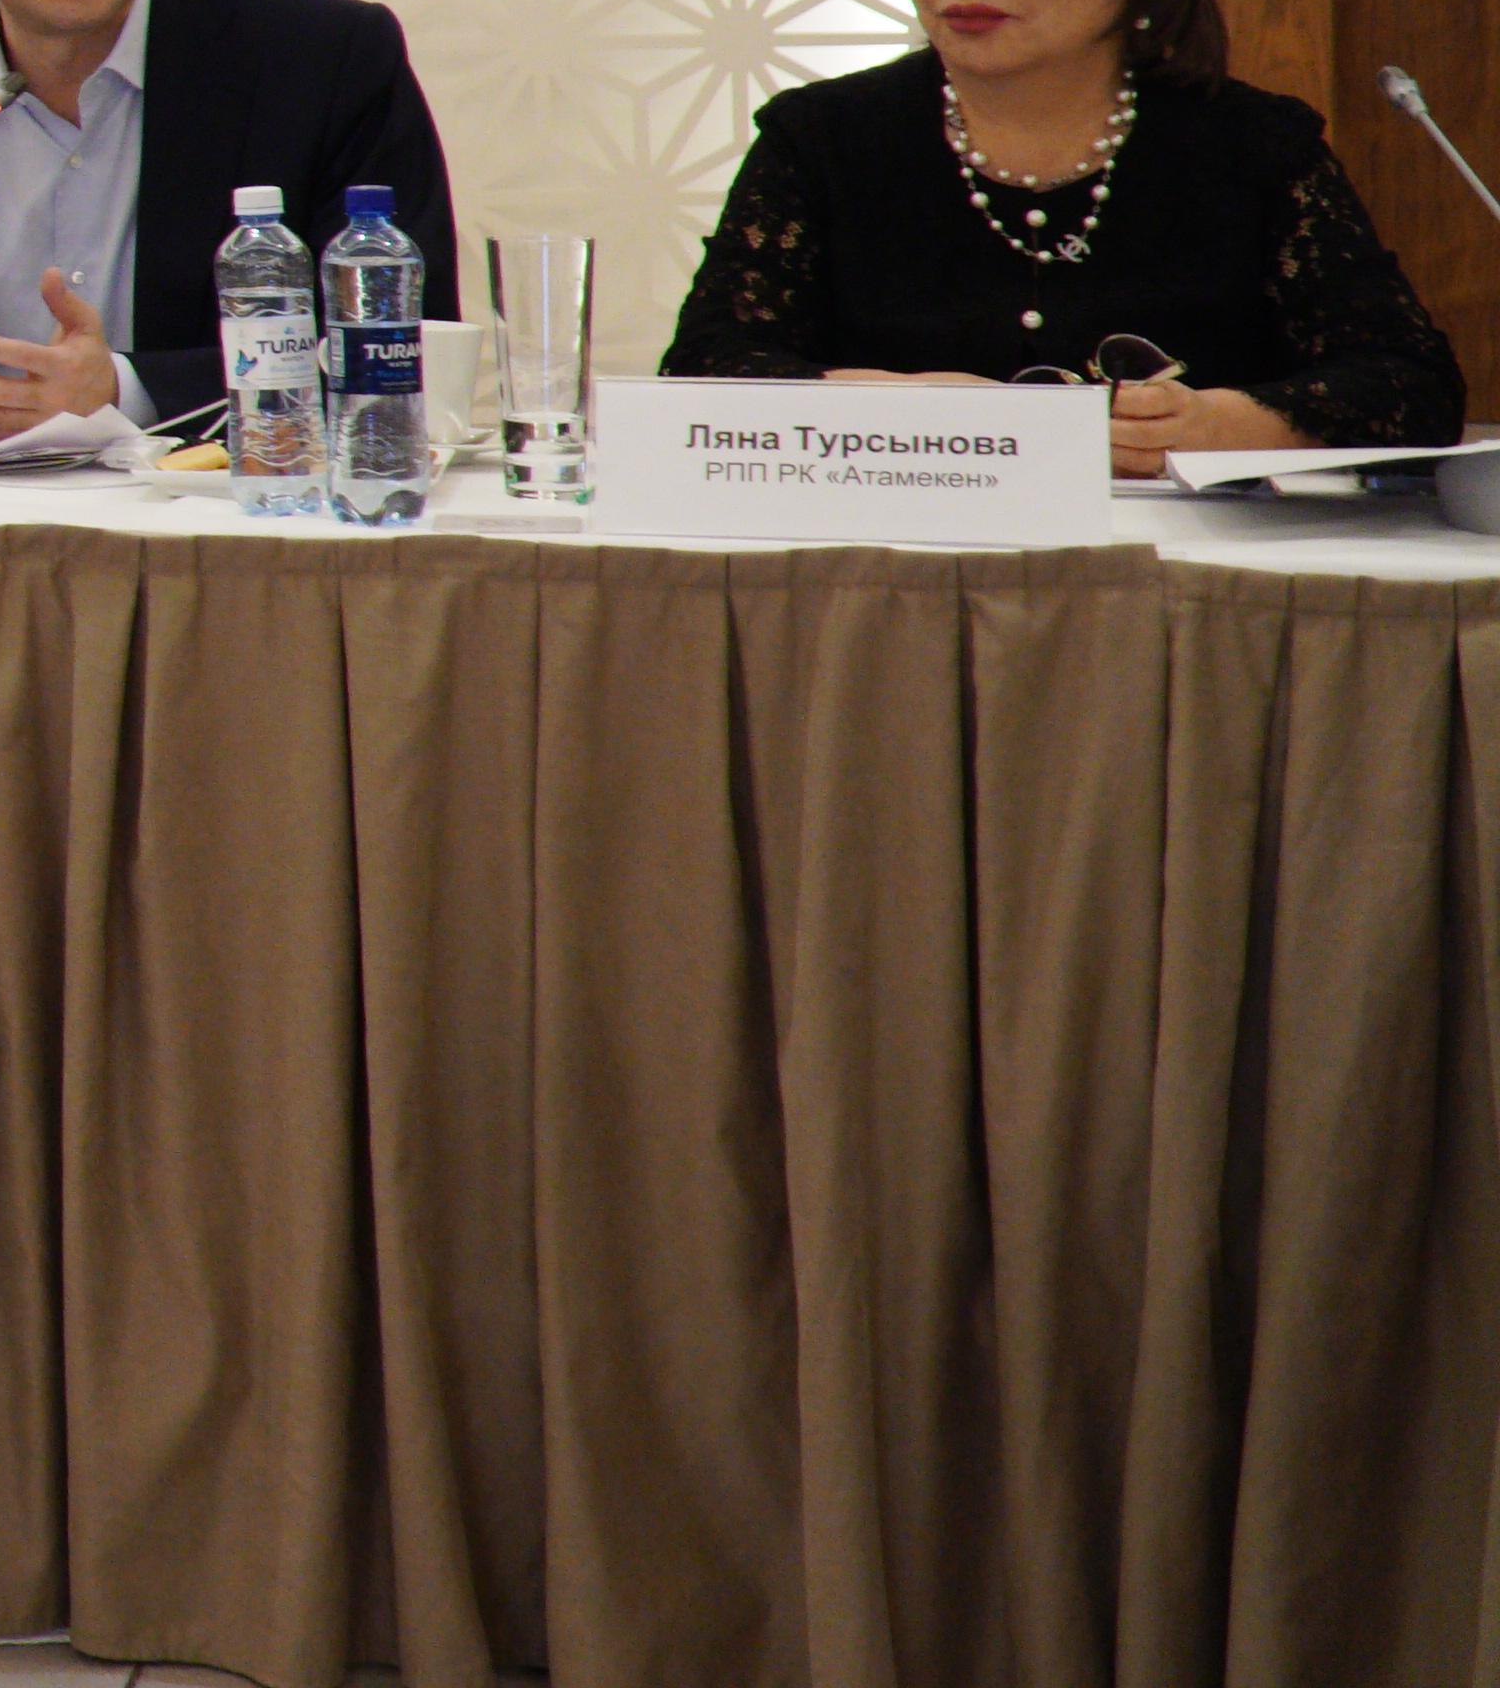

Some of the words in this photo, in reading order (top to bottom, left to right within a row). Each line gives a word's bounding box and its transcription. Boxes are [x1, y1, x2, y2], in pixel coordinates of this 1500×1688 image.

[685, 424, 780, 450] Ляна
[793, 426, 1019, 458] Турсынова
[705, 461, 768, 483] РПП
[778, 463, 817, 484] РК
[826, 465, 999, 489] «Атамекен»
